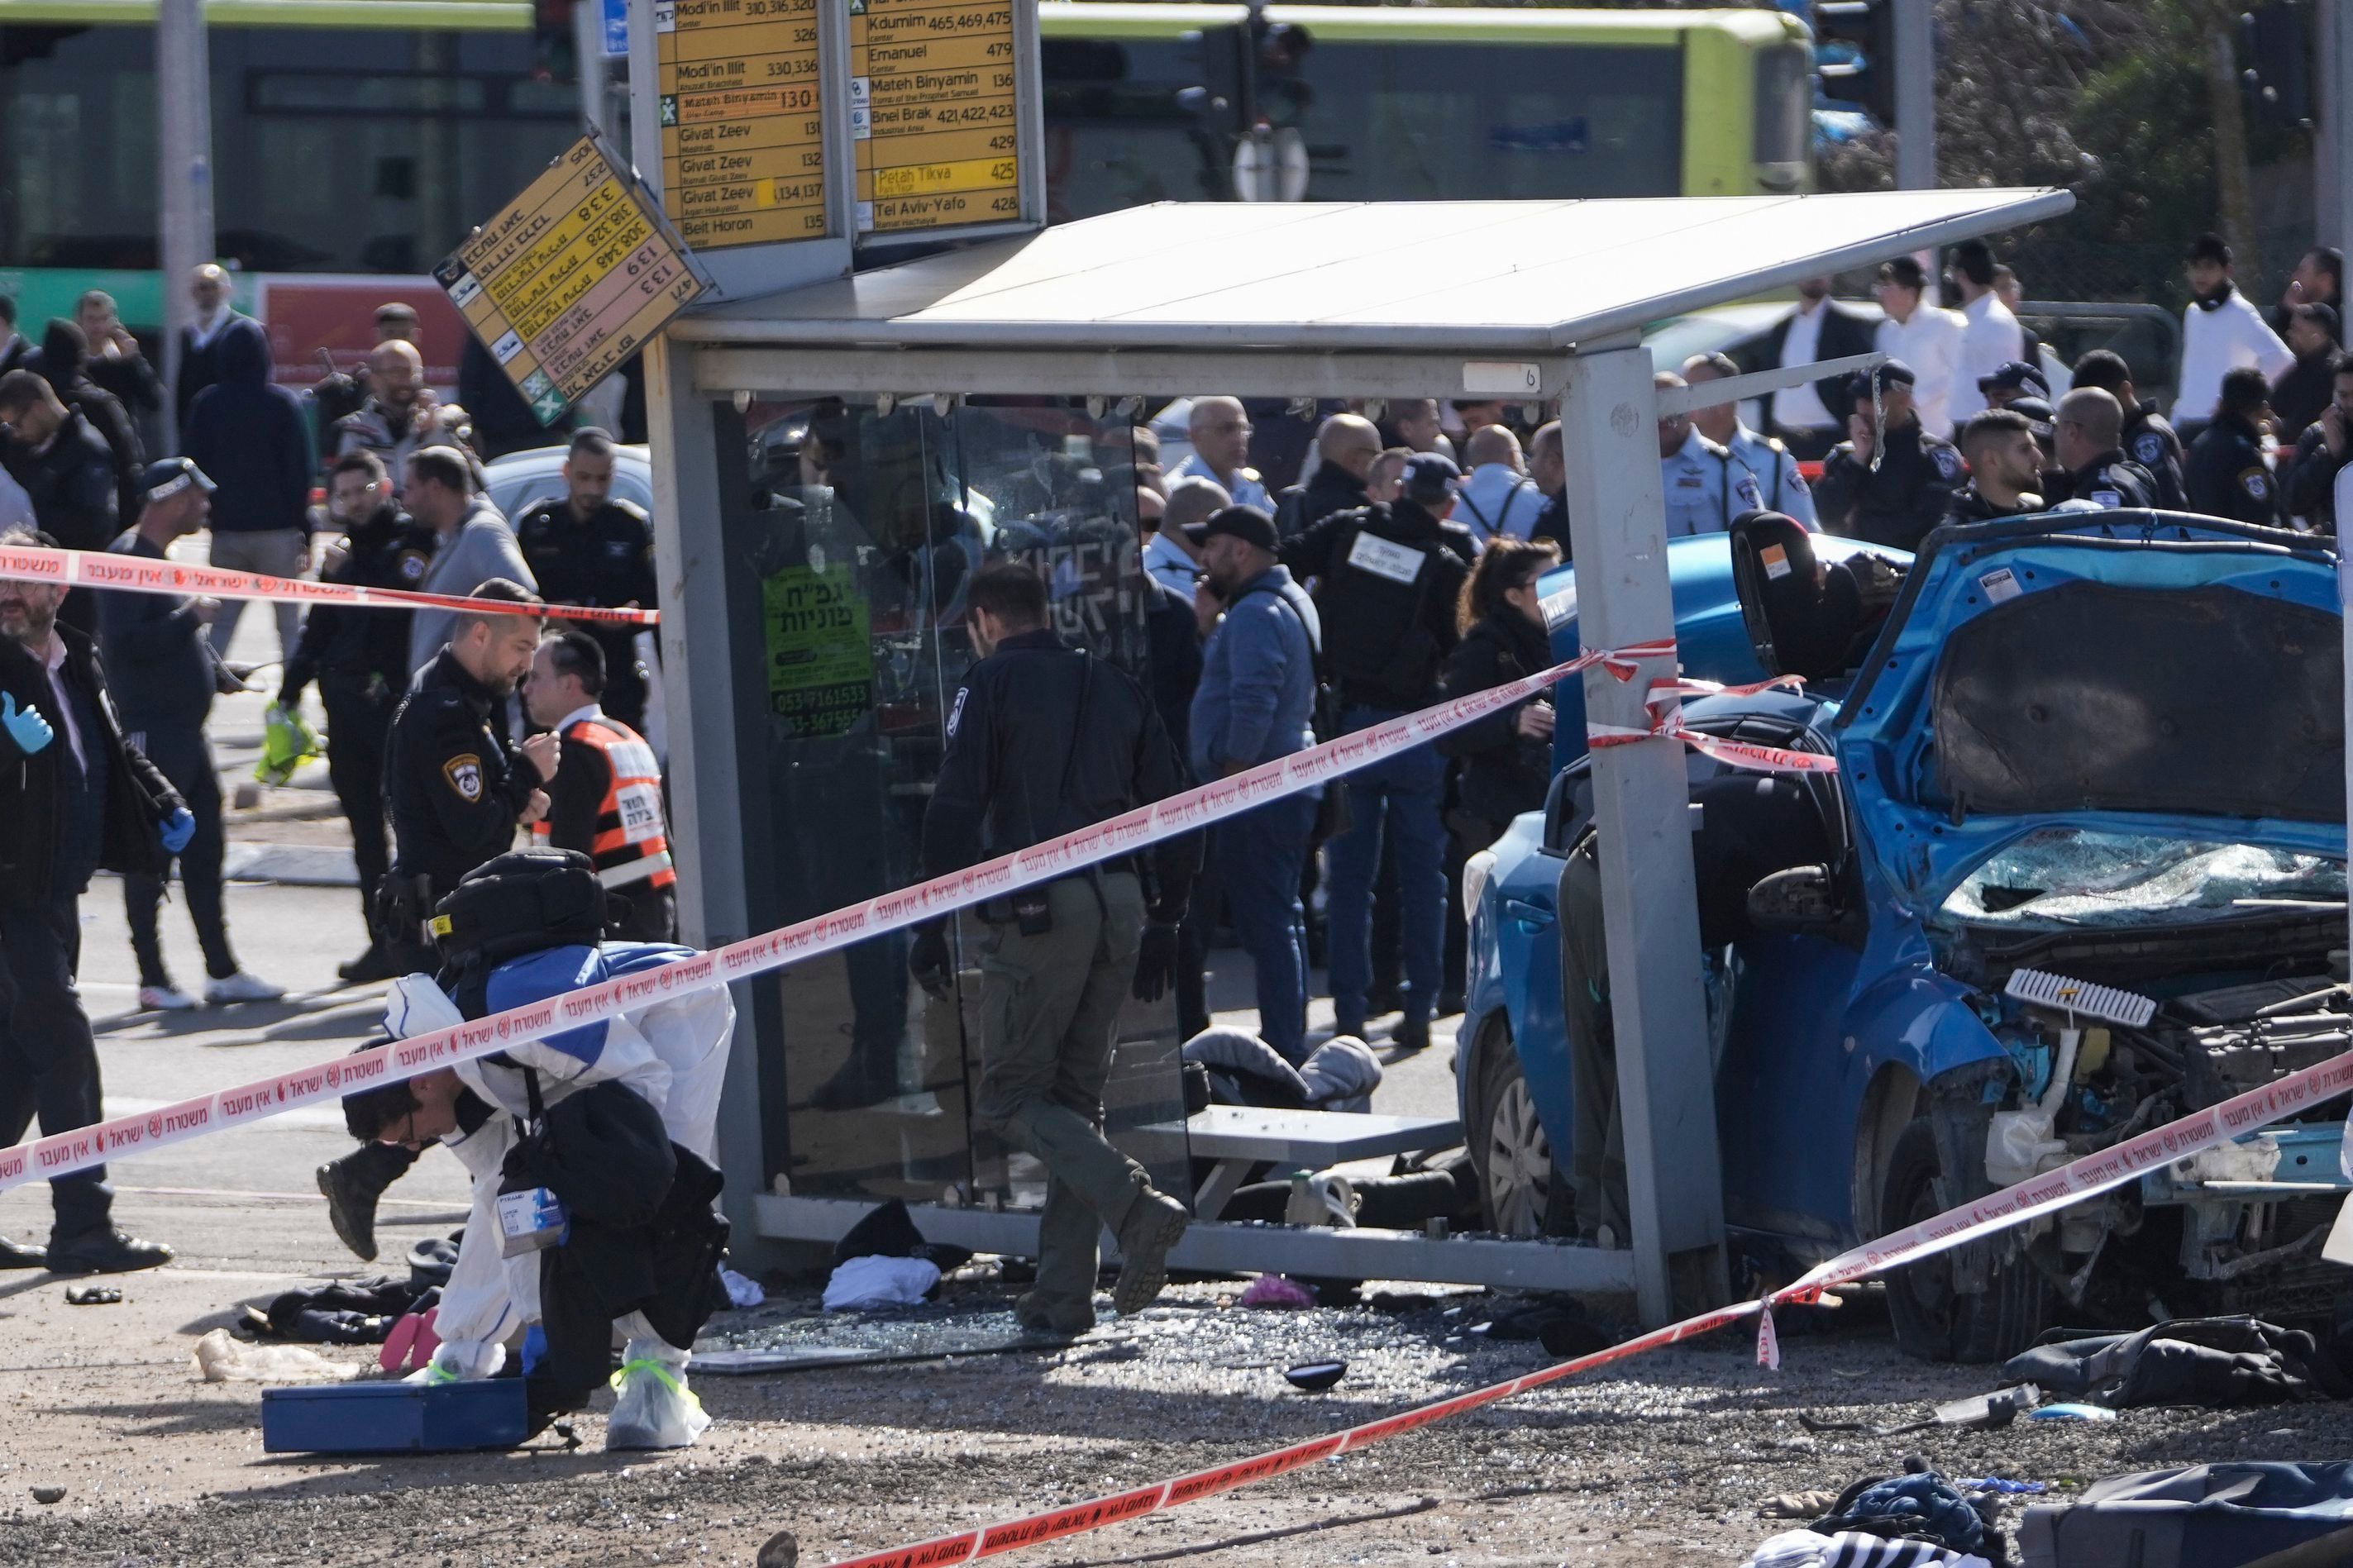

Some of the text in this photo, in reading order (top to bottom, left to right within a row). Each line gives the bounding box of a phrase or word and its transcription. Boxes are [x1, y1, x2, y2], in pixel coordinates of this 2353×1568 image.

[676, 2, 721, 17] Modi'in
[745, 0, 815, 17] 310,316,320
[870, 11, 1012, 32] Kdumim 465,469,475
[793, 28, 818, 42] 326
[871, 42, 1013, 62] Emanuel 479
[678, 60, 818, 79] Modi'in Illit 330,336
[871, 71, 1013, 93] Mateh Binyamin 136
[685, 90, 810, 108] Mateh Binyamin 130
[872, 104, 1014, 125] Bnei Brak 421,422,423
[680, 122, 820, 141] Givat Zeev 131
[990, 135, 1015, 150] 429
[682, 153, 822, 173] Givat Zeev 132
[879, 163, 1015, 185] Petah Tikva 425
[465, 231, 499, 264] גבעת
[499, 208, 524, 234] זאב
[570, 142, 592, 164] 105
[684, 189, 717, 203] Givat
[722, 187, 753, 201] Zeev
[876, 196, 1018, 217] Tel Aviv-Yafo 428
[475, 242, 515, 280] הורדה
[515, 215, 550, 245] בלבד
[584, 160, 607, 187] 237
[685, 214, 824, 236] Beit Horon 135
[494, 185, 613, 300] מודיעין עילית 338
[507, 281, 548, 319] מודיעין
[548, 255, 578, 284] עילית
[585, 203, 631, 246] 318,328
[521, 301, 562, 339] מודיעין
[563, 274, 593, 305] עילית
[594, 221, 647, 270] 308,348
[540, 245, 656, 355] גבעת זאב 139
[553, 347, 582, 374] גבעת
[585, 327, 605, 349] זאב
[640, 265, 671, 293] 133
[562, 380, 584, 399] תל
[583, 350, 615, 382] אביב
[617, 334, 636, 354] יפו
[670, 279, 691, 300] 471
[88, 564, 132, 580] מעבר
[136, 568, 163, 586] אין
[193, 570, 246, 590] ישראל
[1378, 726, 1410, 746] משטרת
[1339, 741, 1363, 755] ישראל
[1291, 760, 1314, 777] מעבר
[1310, 748, 1326, 773] אין
[1250, 771, 1282, 789] משטרת
[1210, 788, 1235, 807] ישראל
[1158, 805, 1182, 824] מעבר
[1182, 800, 1196, 821] אין
[1115, 817, 1148, 836] משטרת
[1071, 830, 1100, 849] ישראל
[1019, 851, 1045, 870] מעבר
[1043, 845, 1058, 867] אין
[976, 861, 1009, 883] משטרת
[931, 880, 959, 900] ישראל
[876, 900, 901, 919] מעבר
[903, 894, 916, 915] אין
[828, 912, 864, 935] משטרת
[782, 929, 811, 950] ישראל
[724, 949, 750, 967] מעבר
[752, 943, 766, 964] אין
[675, 957, 711, 981] משטרת
[626, 978, 656, 998] ישראל
[564, 998, 591, 1016] מעבר
[594, 991, 609, 1013] אין
[513, 1005, 551, 1032] משטרת
[461, 1027, 493, 1047] ישראל
[397, 1046, 427, 1065] מעבר
[429, 1041, 444, 1062] אין
[344, 1058, 384, 1082] משטרת
[289, 1070, 322, 1096] ישראל
[2275, 1075, 2305, 1104] ישראל
[222, 1095, 252, 1115] מעבר
[255, 1089, 271, 1113] אין
[2248, 1096, 2265, 1121] אין
[164, 1105, 208, 1132] משטרת
[2222, 1102, 2250, 1127] מעבר
[108, 1126, 143, 1147] ישראל
[2177, 1117, 2214, 1148] משטרת
[37, 1146, 69, 1165] מעבר
[71, 1136, 88, 1161] אין
[2131, 1137, 2164, 1165] ישראל
[2078, 1166, 2107, 1188] מעבר
[2105, 1161, 2124, 1180] אין
[2032, 1182, 2070, 1203] משטרת
[1984, 1203, 2017, 1220] ישראל
[918, 1543, 941, 1564] אין
[939, 1541, 970, 1560] מעבר
[984, 1527, 1033, 1549] משטרת
